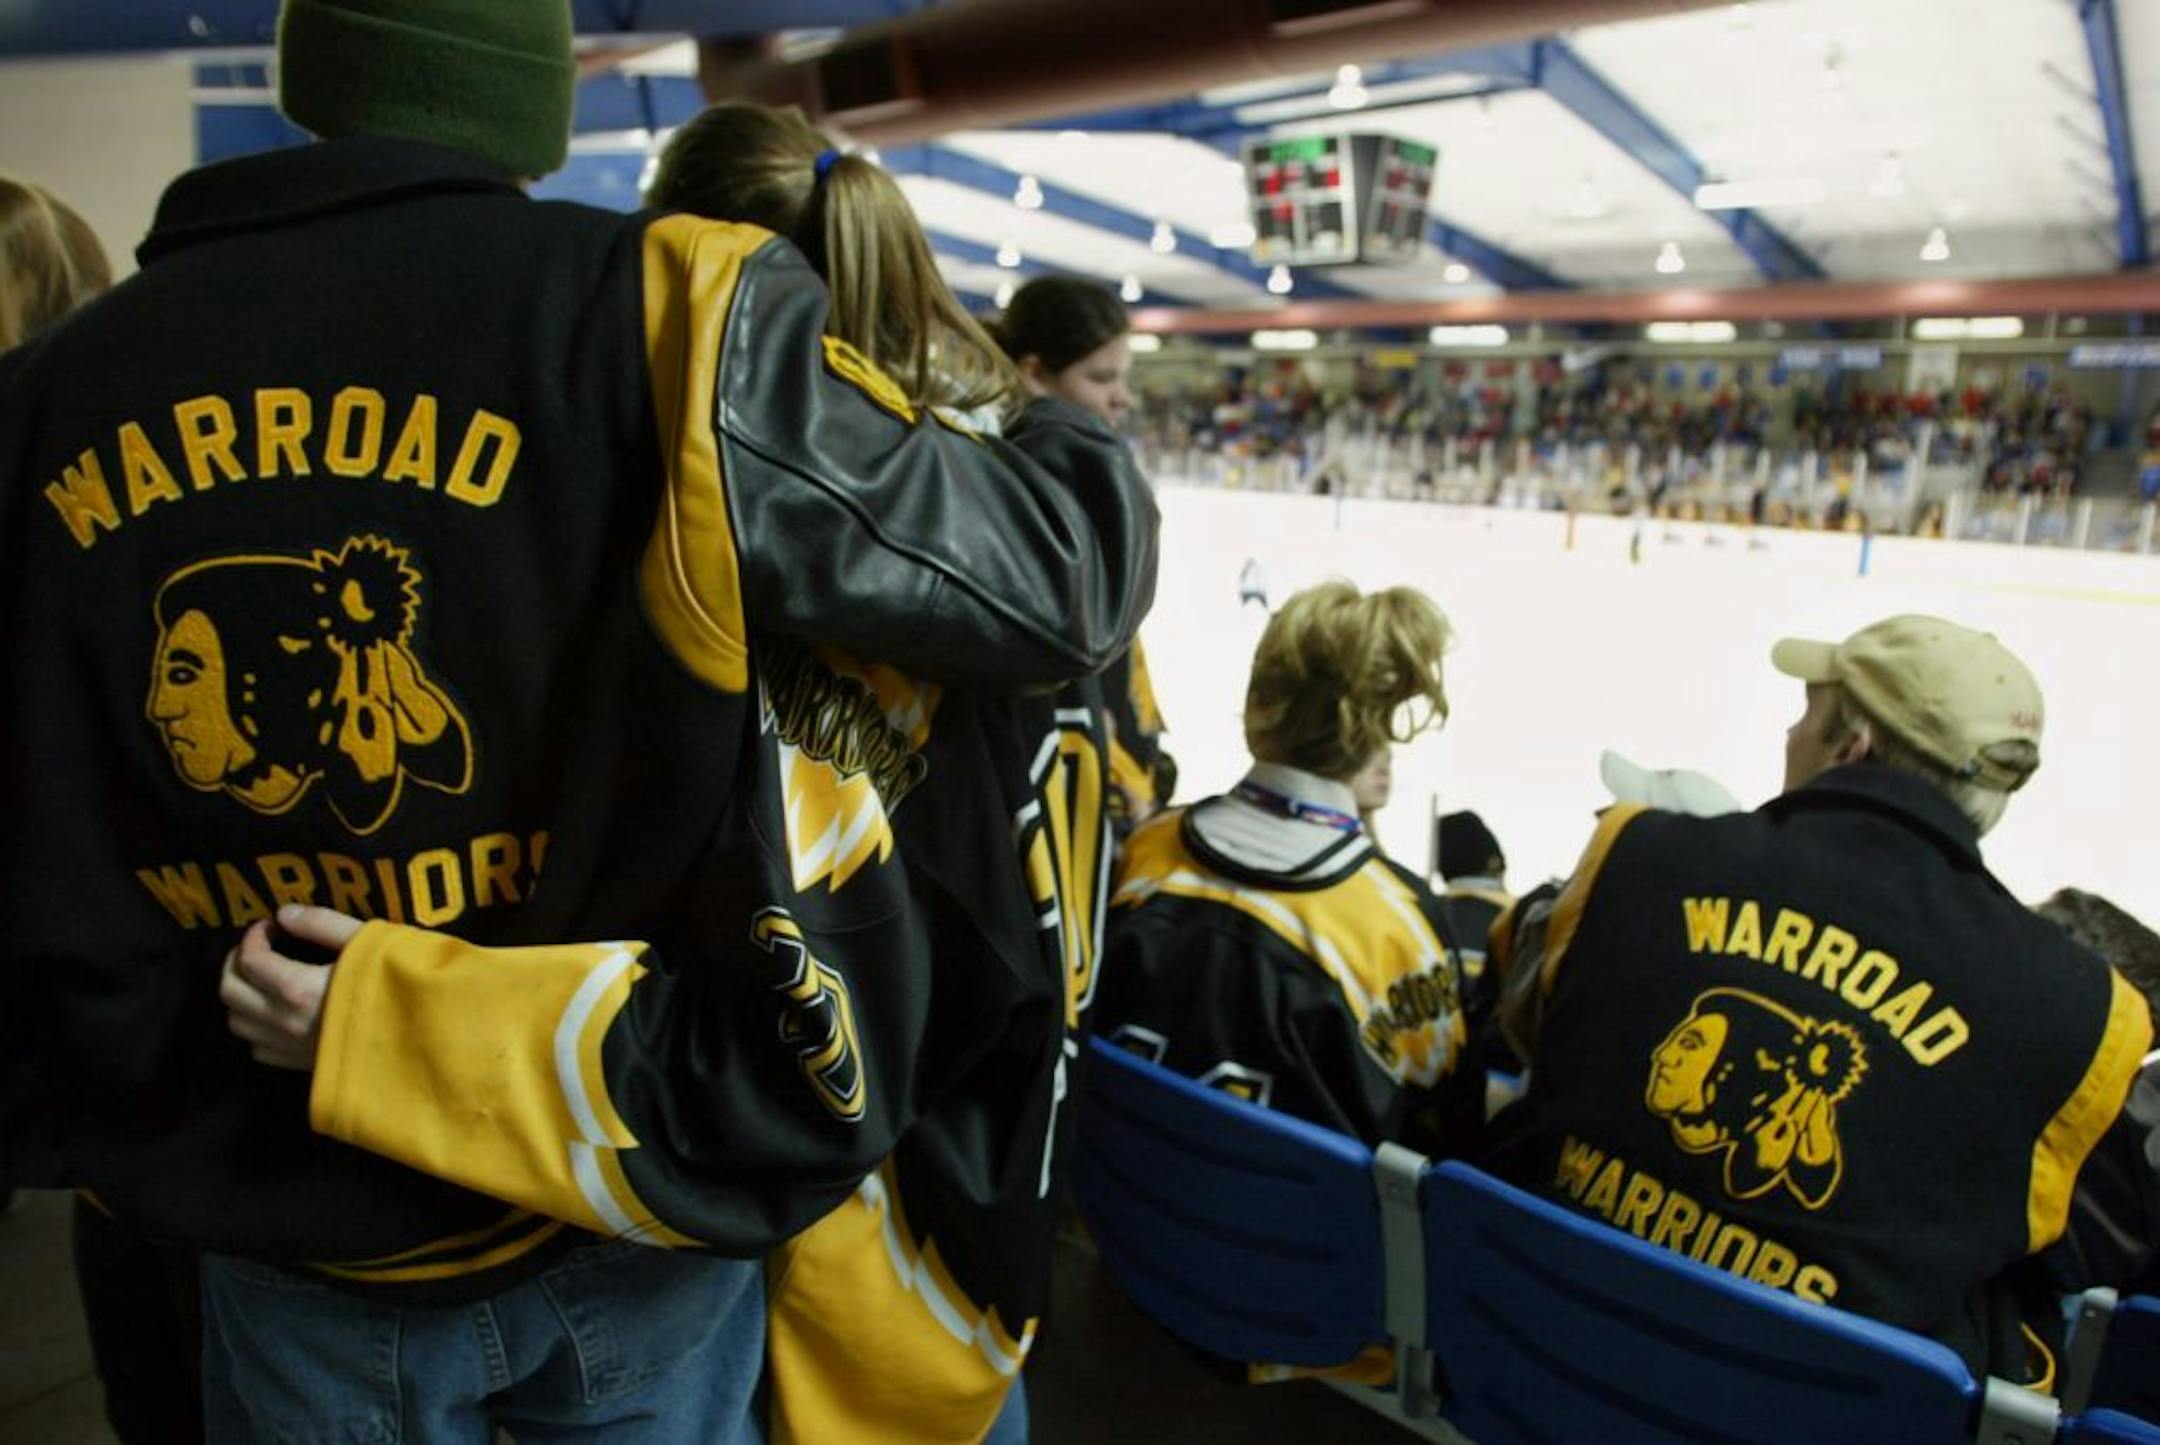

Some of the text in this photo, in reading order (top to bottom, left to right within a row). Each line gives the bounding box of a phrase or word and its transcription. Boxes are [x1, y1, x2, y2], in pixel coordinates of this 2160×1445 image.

[44, 386, 523, 549] WARROAD
[1684, 897, 1970, 1067] WARROAD
[1555, 1134, 1839, 1305] WARRIORS
